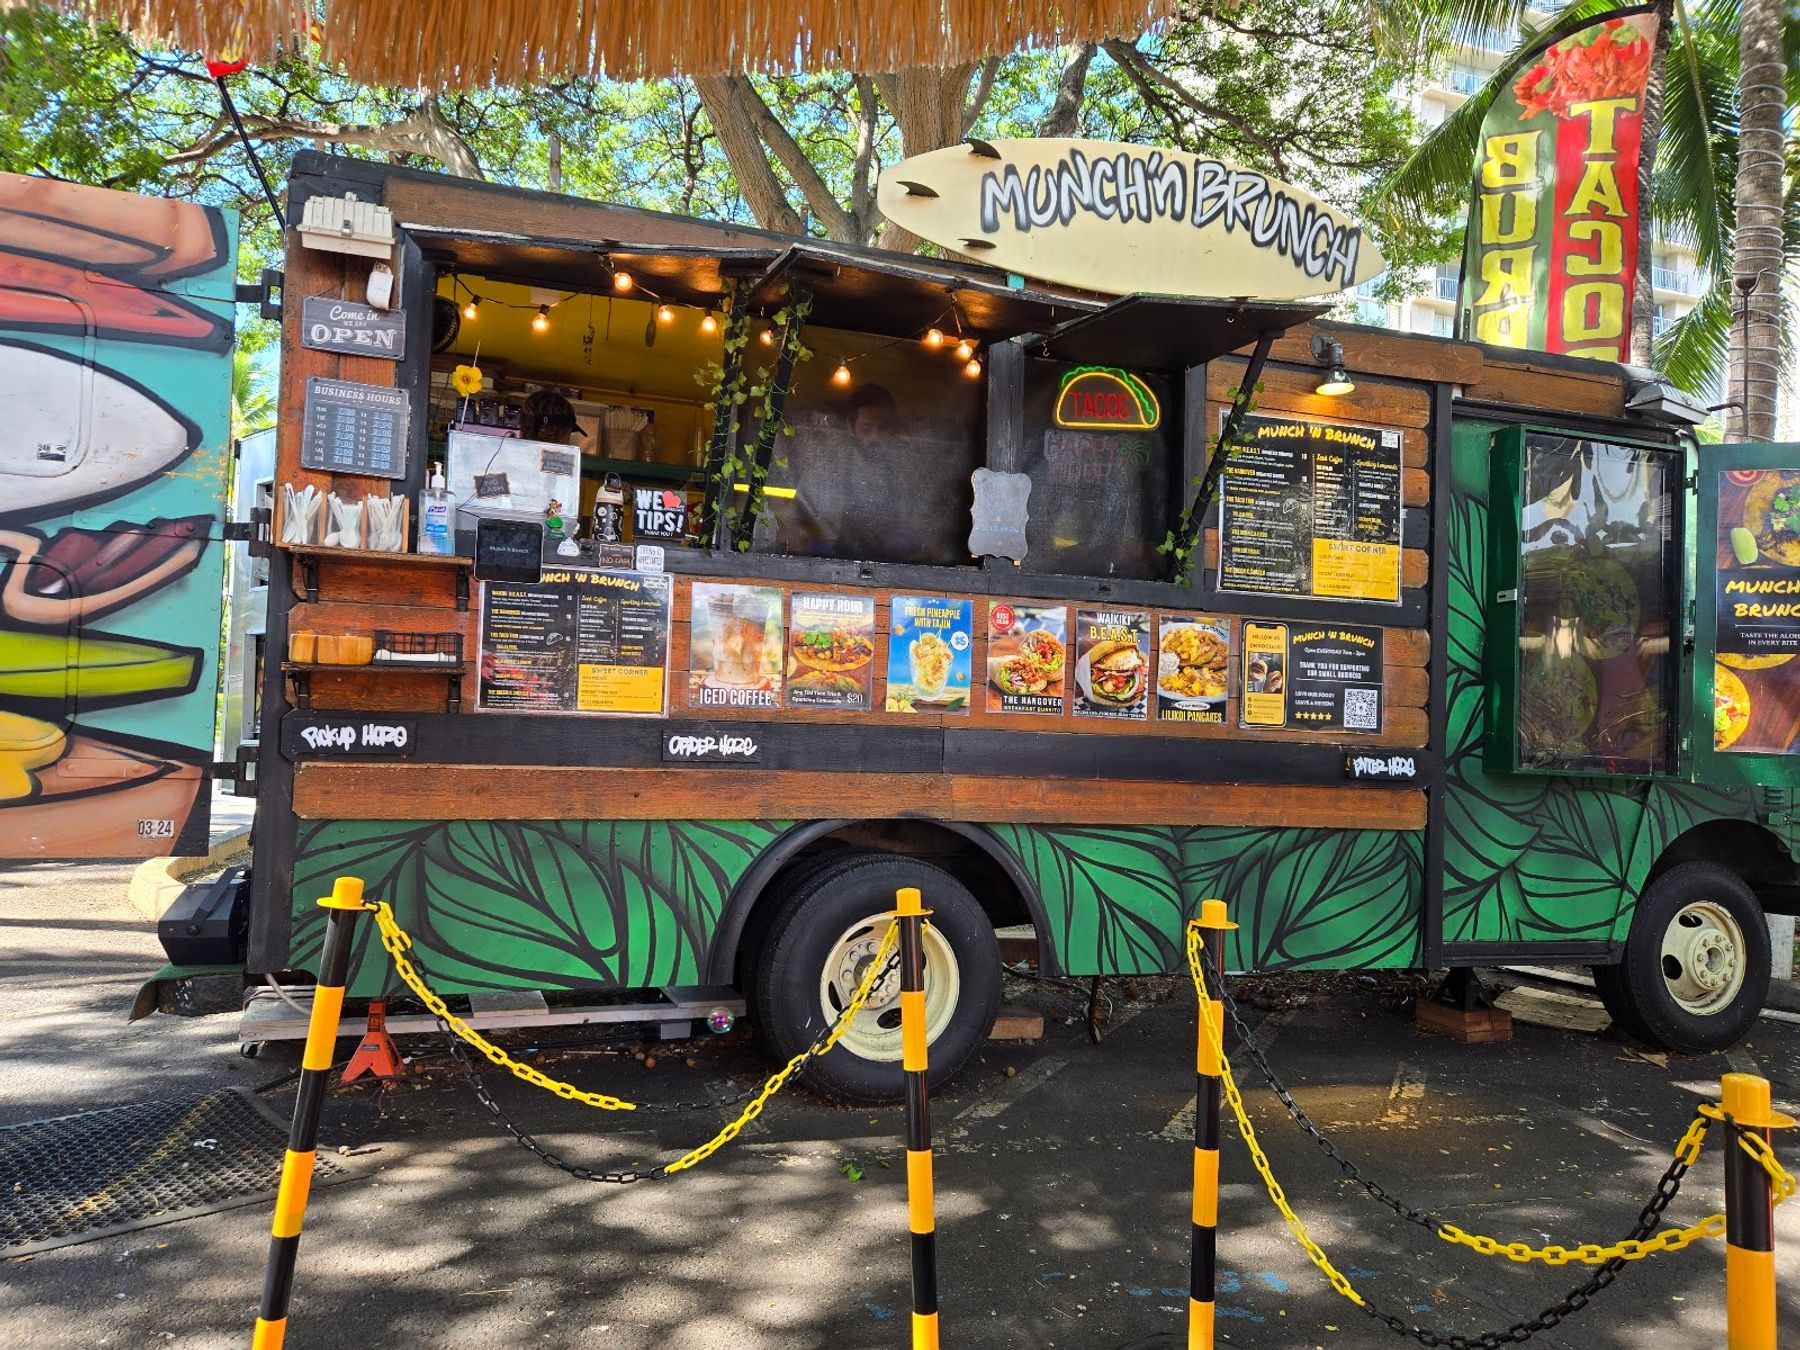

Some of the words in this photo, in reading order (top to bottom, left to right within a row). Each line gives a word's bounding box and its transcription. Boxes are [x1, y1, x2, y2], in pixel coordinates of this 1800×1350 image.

[1190, 157, 1362, 289] BRUNCH
[330, 305, 365, 320] Come
[367, 310, 380, 320] in
[311, 324, 397, 349] OPEN
[314, 386, 365, 399] BUSINESS
[367, 393, 402, 405] HOURS
[1069, 390, 1131, 419] TACOS
[1257, 426, 1305, 438] MUNCH
[1325, 428, 1376, 450] BRUNCH
[635, 489, 663, 510] WE
[636, 509, 684, 533] TIPS!
[590, 574, 640, 591] BRUNCH
[1725, 580, 1800, 594] MUNCH
[803, 597, 835, 610] HAPPY
[837, 599, 863, 613] HOUR
[1734, 603, 1800, 617] BRUNC
[905, 606, 926, 617] FRESH
[927, 607, 960, 620] PINEAPPLE
[1097, 612, 1131, 625] WAIKIKI
[914, 617, 931, 628] WITH
[1090, 626, 1141, 643] B.E.A.S.T.
[1293, 631, 1325, 645] MUNCH
[1338, 631, 1375, 648] BRUNCH
[617, 668, 648, 676] CORNER
[1299, 661, 1316, 669] THANK
[1340, 663, 1370, 672] SUPPORTING
[1318, 670, 1336, 678] SMALL
[700, 688, 727, 705] ICED
[731, 688, 772, 706] COFFEE
[847, 692, 863, 704] $20
[1003, 695, 1018, 704] THE
[1021, 696, 1062, 707] HANGOVER
[1162, 709, 1186, 721] LILIKOI
[1187, 711, 1222, 723] PANCAKES
[138, 820, 152, 835] 03
[157, 821, 171, 835] 24
